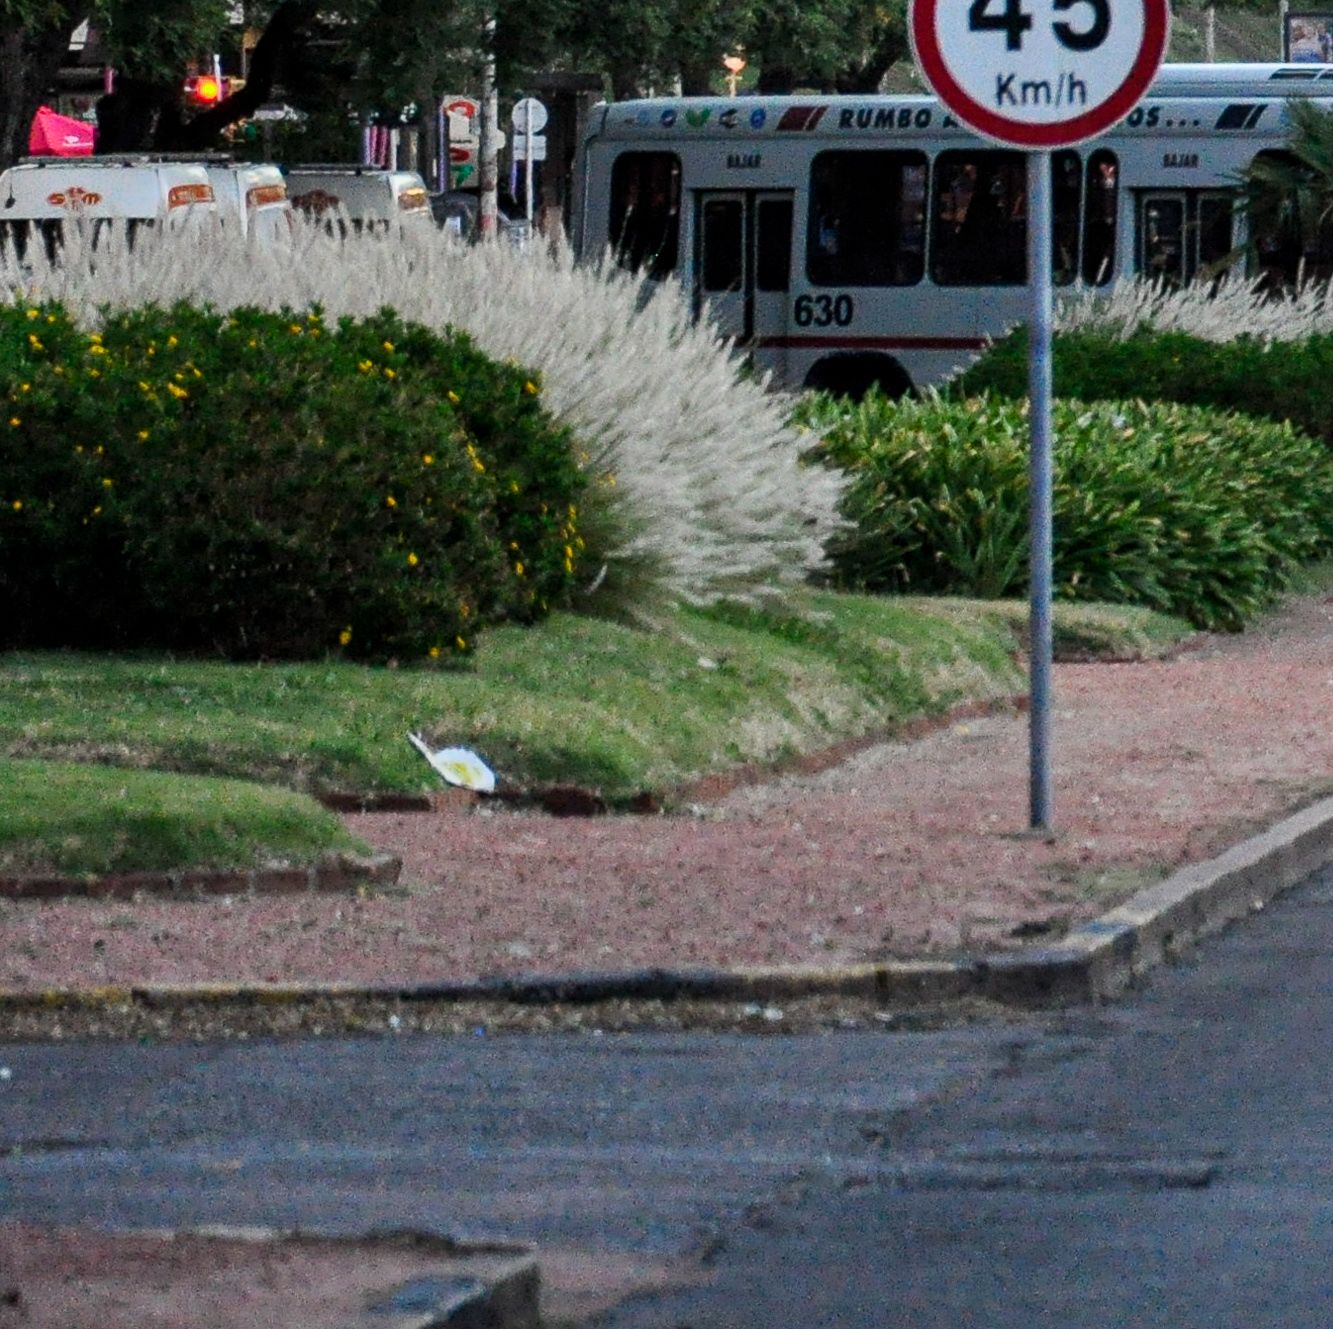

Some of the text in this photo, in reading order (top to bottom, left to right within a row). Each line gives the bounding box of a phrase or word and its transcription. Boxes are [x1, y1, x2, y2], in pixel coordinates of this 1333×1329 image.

[996, 73, 1087, 108] Km/h
[838, 108, 932, 129] RUMBO
[794, 294, 854, 327] 630
